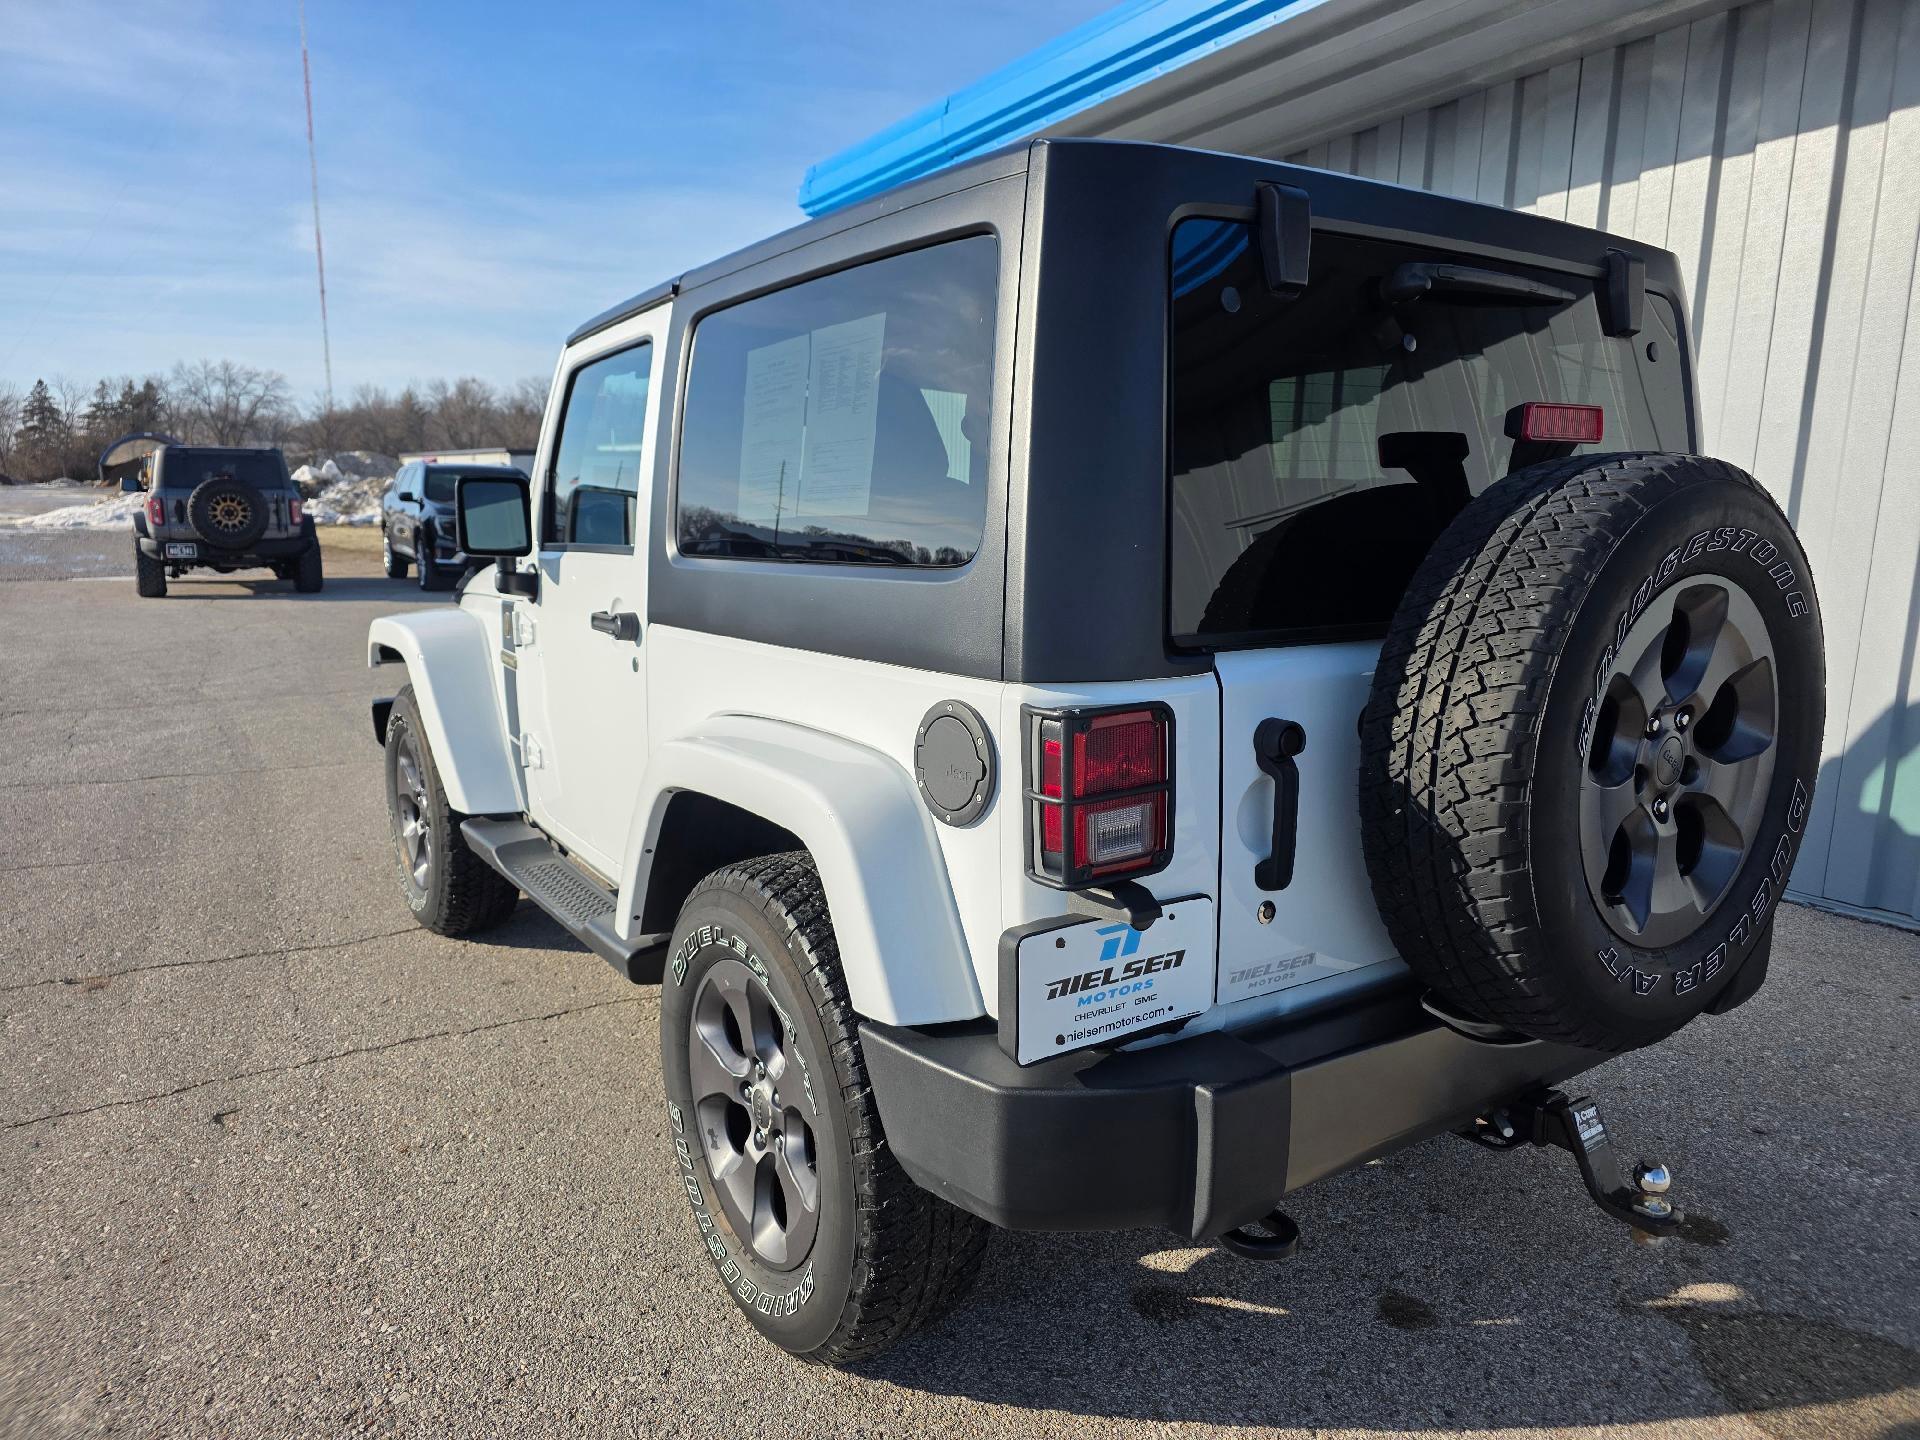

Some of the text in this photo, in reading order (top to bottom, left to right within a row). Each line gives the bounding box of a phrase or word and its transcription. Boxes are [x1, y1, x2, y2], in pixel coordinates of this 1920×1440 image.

[1578, 527, 1809, 768] BRIDGESTONE
[1598, 779, 1808, 996] DUELER A/T
[671, 925, 770, 987] DUELER
[1044, 949, 1187, 1001] NIELSEN
[1229, 952, 1317, 985] NIELSEN
[1077, 978, 1154, 1008] MOTORS
[1247, 971, 1296, 989] MOTORS
[1066, 1007, 1166, 1043] nielsenmotors.com
[1074, 993, 1158, 1022] CHEVROLET GMC
[668, 1100, 815, 1317] BRIDGESTONE
